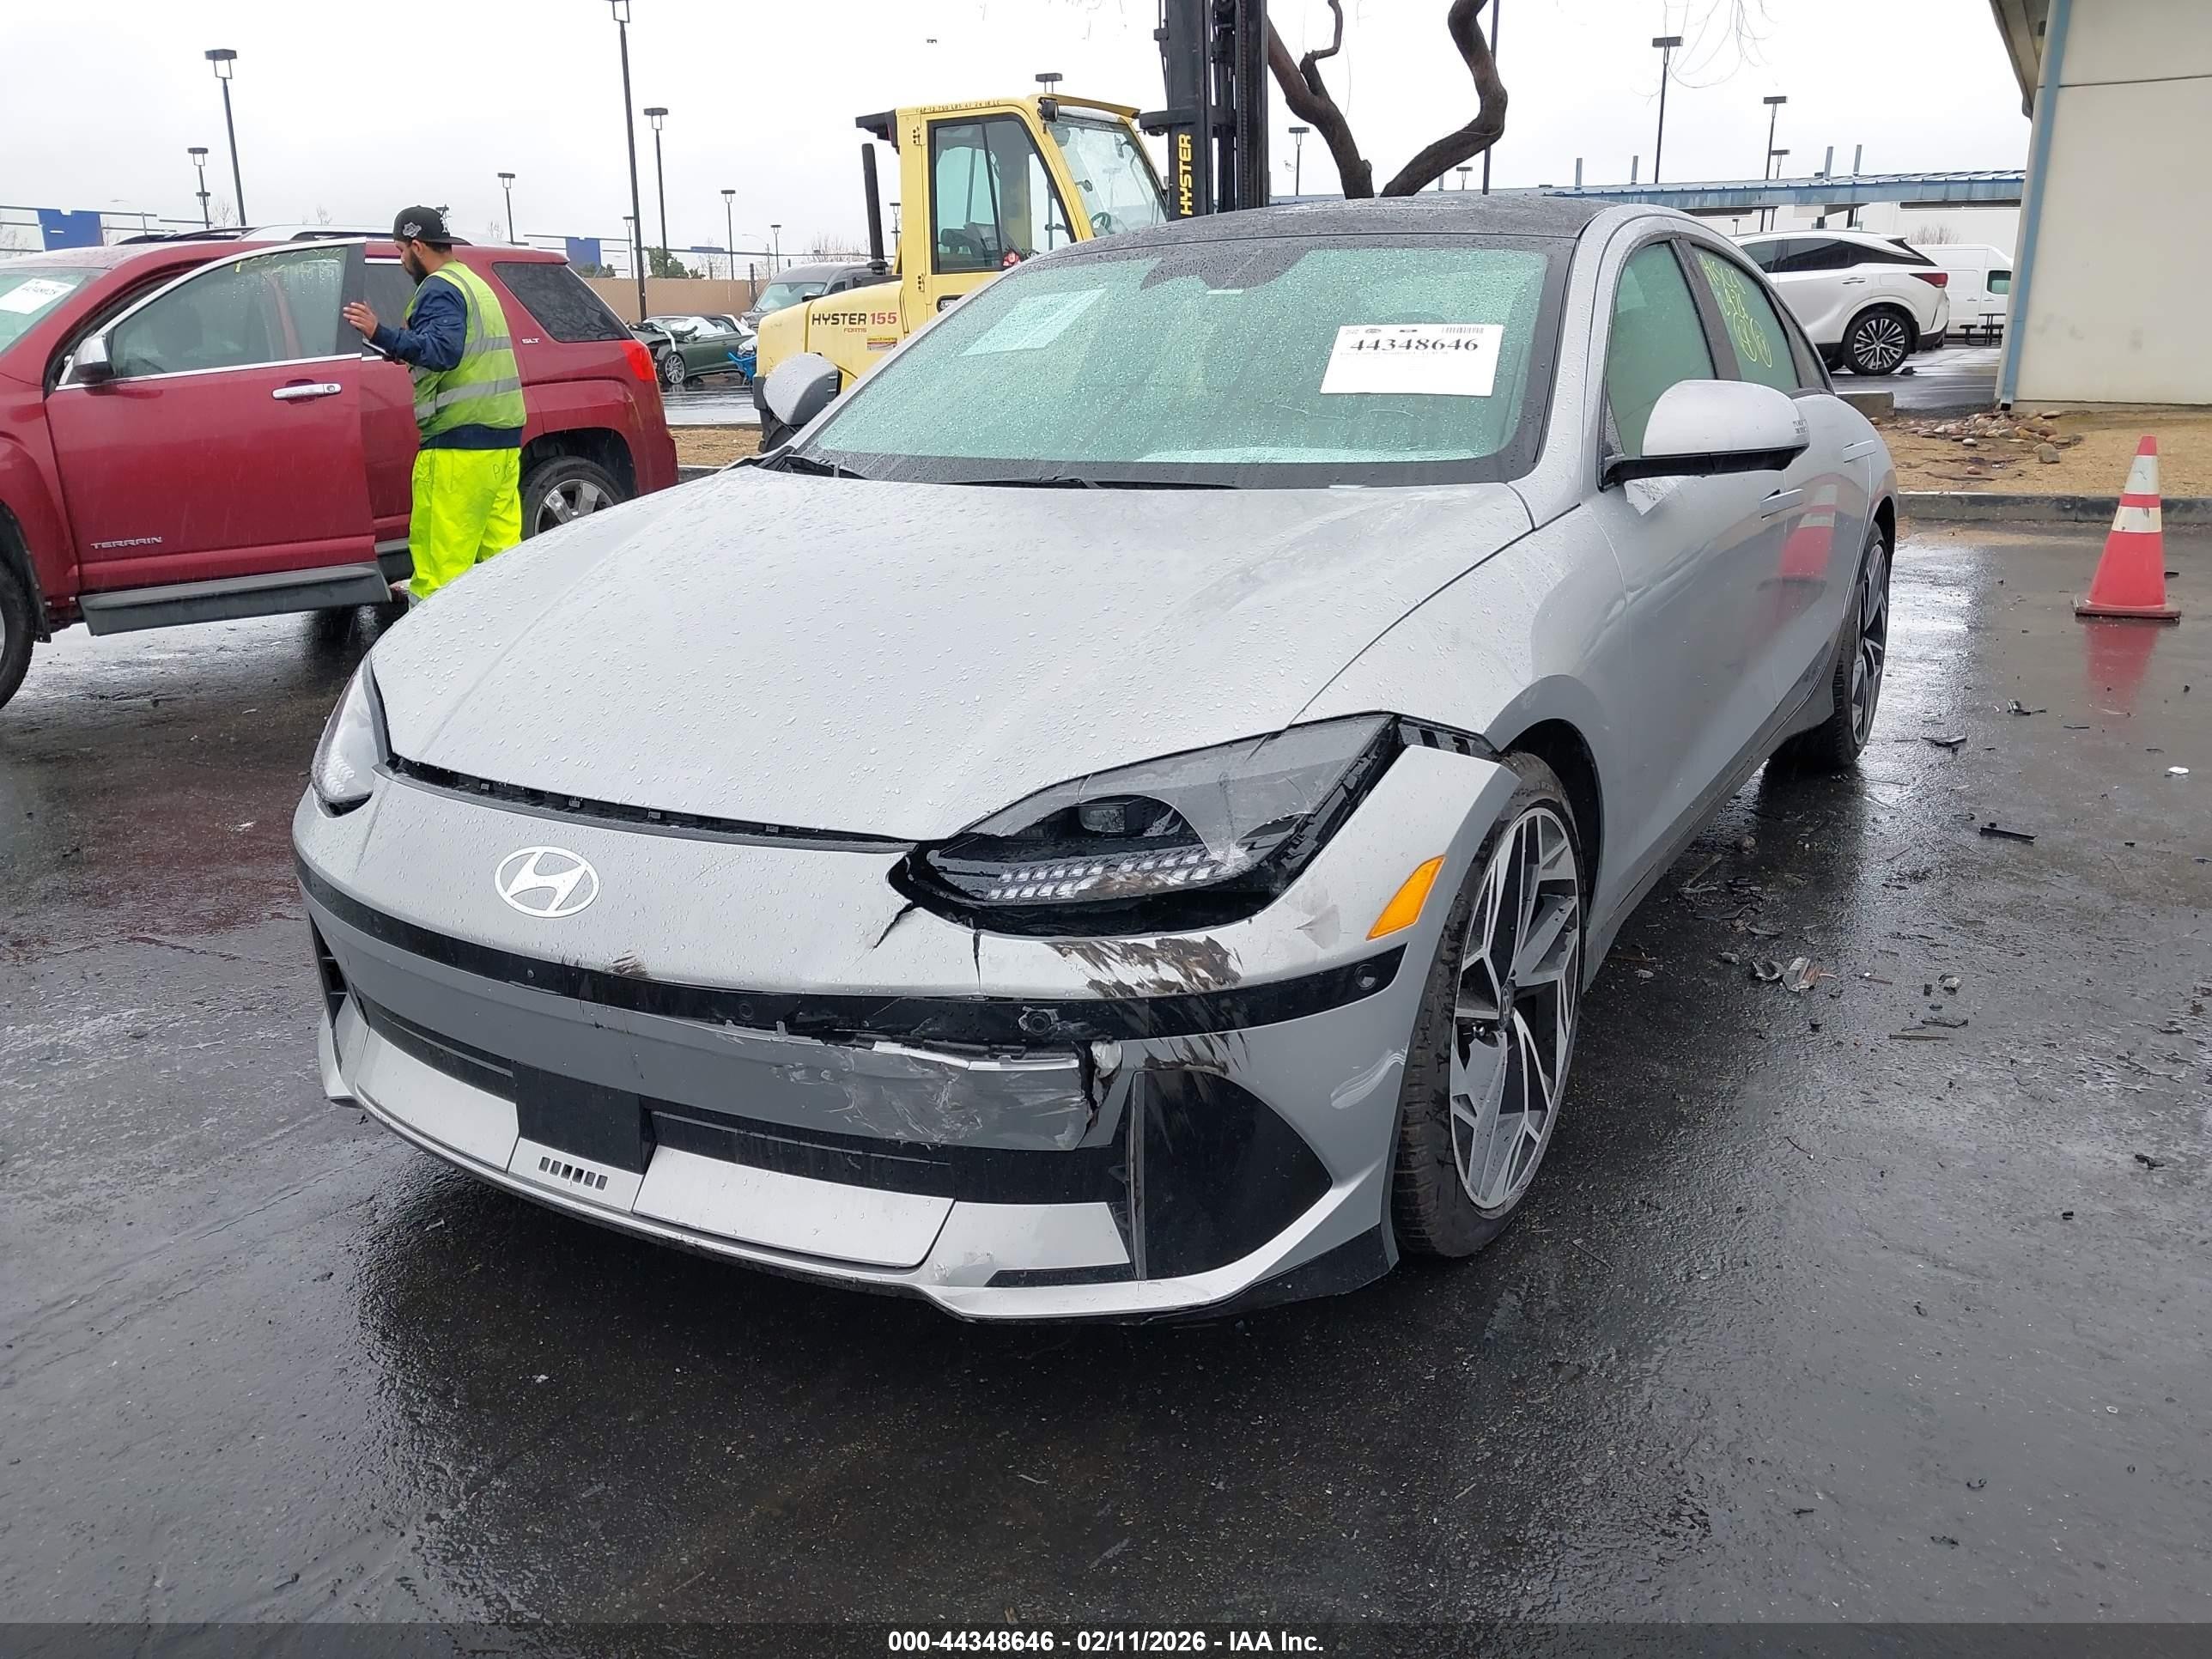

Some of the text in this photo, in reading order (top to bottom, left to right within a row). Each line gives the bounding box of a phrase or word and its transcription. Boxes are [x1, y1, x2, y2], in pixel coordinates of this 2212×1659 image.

[1178, 133, 1193, 216] HYSTER
[811, 312, 897, 325] HYSTER 155
[1350, 337, 1480, 351] 44348646
[90, 536, 162, 550] TERRAIN
